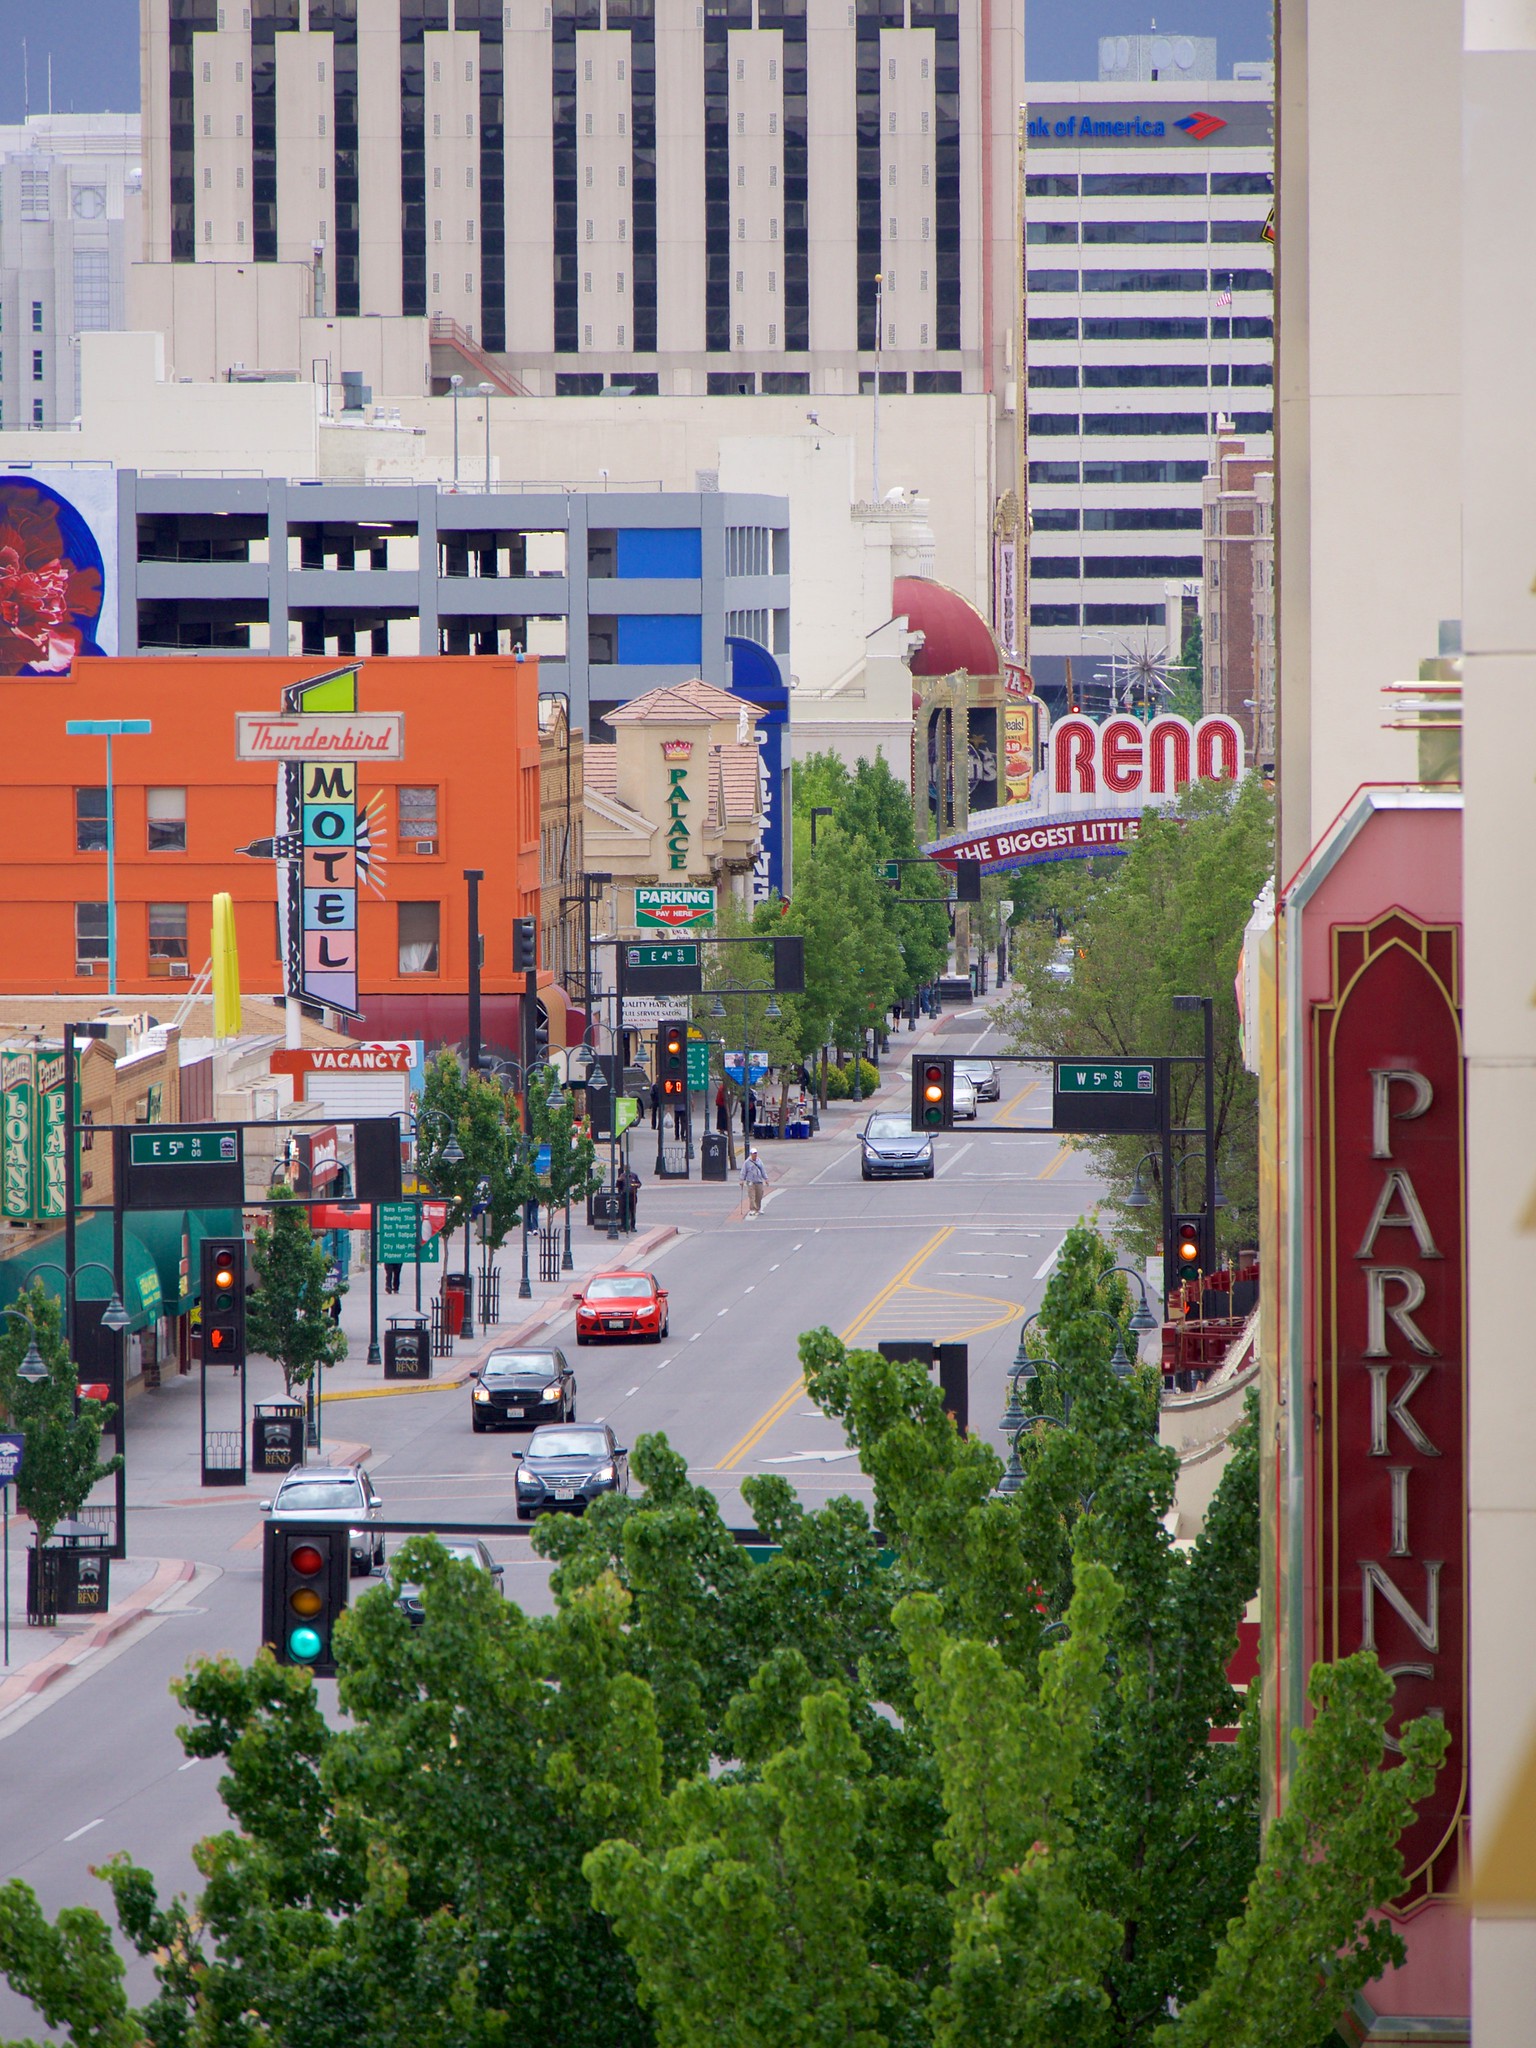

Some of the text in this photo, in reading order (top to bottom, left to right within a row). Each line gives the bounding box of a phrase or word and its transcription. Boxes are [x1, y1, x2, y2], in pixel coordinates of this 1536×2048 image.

[1055, 116, 1078, 136] of
[1079, 116, 1165, 136] America
[248, 722, 392, 751] Thunderbird
[1055, 720, 1238, 794] RENO
[665, 768, 690, 870] PALACE
[954, 822, 1139, 860] THE BIGGEST LITTLE
[307, 767, 352, 967] MOTEL
[640, 891, 710, 904] PARKING
[651, 951, 657, 961] E
[661, 950, 673, 961] 4th
[311, 1053, 402, 1069] VACANCY
[1077, 1071, 1122, 1085] W 5th St
[7, 1094, 28, 1215] LOANS
[153, 1138, 201, 1156] E 5th St
[396, 1364, 418, 1373] RENO
[265, 1454, 290, 1465] RENO
[77, 1592, 99, 1604] RENO
